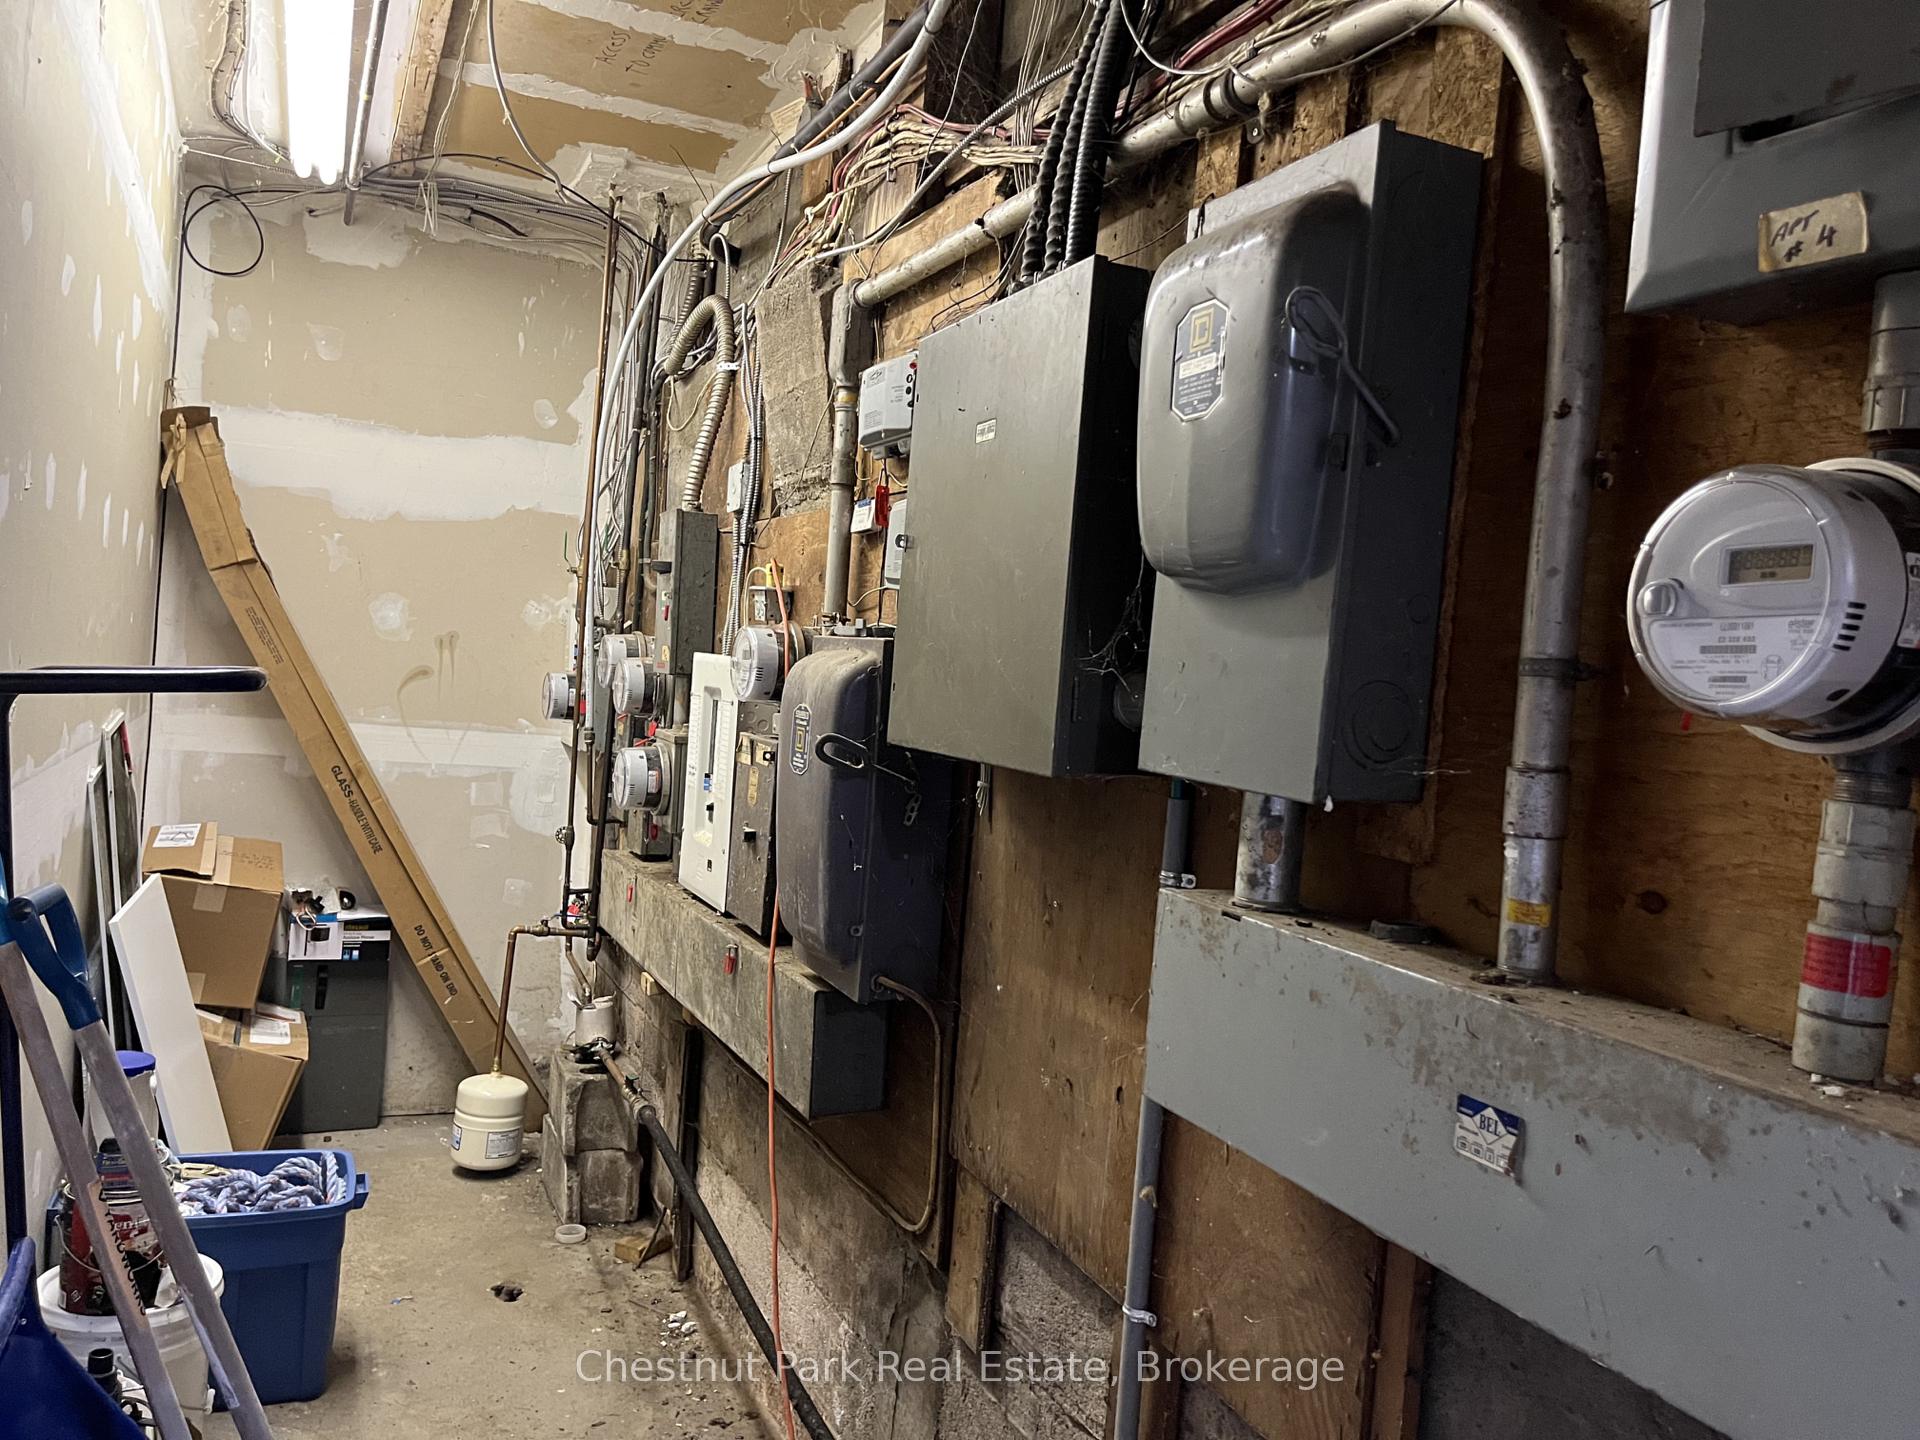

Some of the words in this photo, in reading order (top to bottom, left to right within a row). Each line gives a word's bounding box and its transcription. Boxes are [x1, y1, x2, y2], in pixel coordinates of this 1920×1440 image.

[1770, 209, 1819, 247] APT
[1816, 224, 1838, 247] 4
[331, 765, 353, 798] GLASS
[414, 925, 425, 936] DO
[420, 937, 433, 950] NOT
[440, 972, 450, 984] ON
[446, 982, 458, 996] END
[1480, 1114, 1499, 1136] BEL
